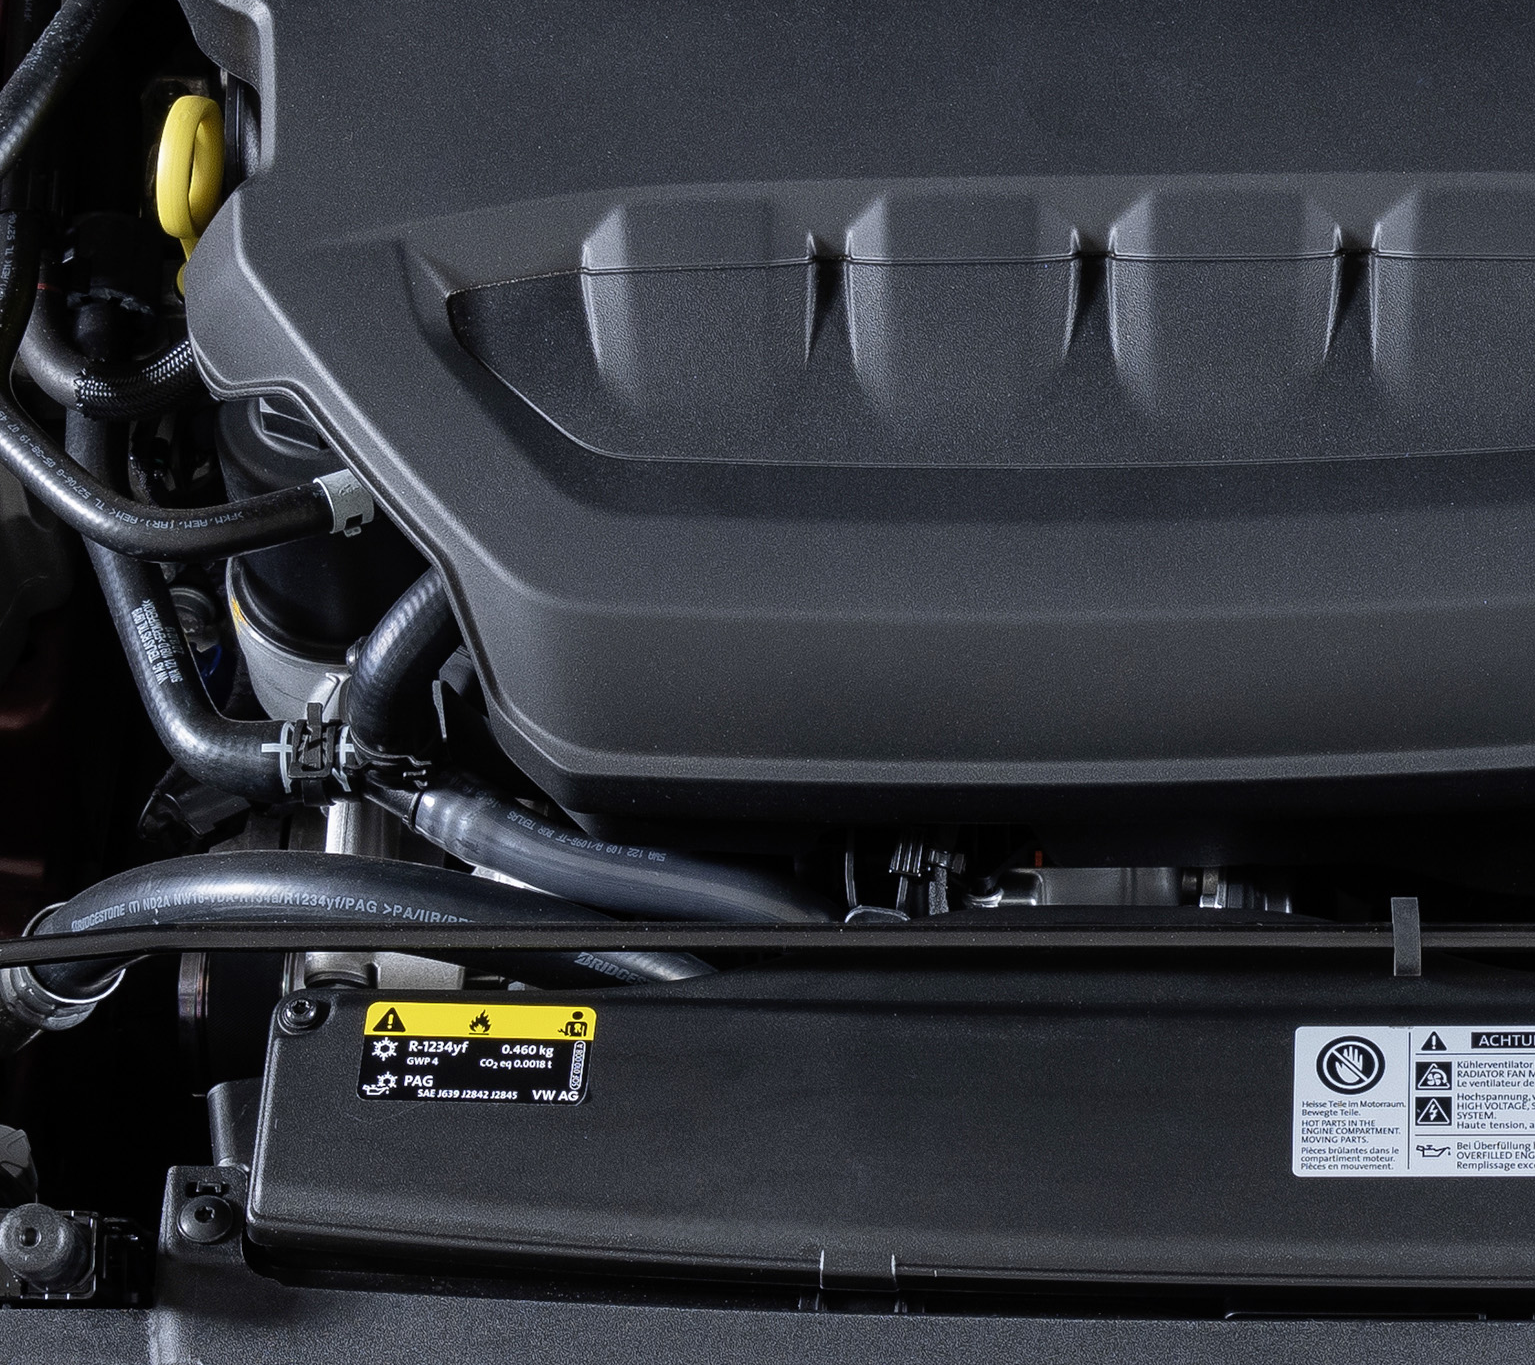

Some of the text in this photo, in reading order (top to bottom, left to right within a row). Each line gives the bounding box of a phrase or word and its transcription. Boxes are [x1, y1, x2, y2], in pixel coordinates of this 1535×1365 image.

[506, 810, 537, 831] TEKLAS
[606, 844, 623, 855] 109
[628, 847, 644, 859] 122
[71, 902, 126, 933] BRIDGESTONE
[408, 1040, 554, 1058] R-1234yf 0.460 kg
[406, 1057, 439, 1066] GWP 4
[500, 1061, 512, 1070] eq
[513, 1059, 545, 1068] 0.0018
[547, 1060, 552, 1068] t
[1457, 1060, 1534, 1069] Kühlerventilator
[1457, 1070, 1505, 1078] RADIATOR
[1507, 1070, 1526, 1078] FAN
[403, 1075, 434, 1087] PAG
[1457, 1079, 1468, 1088] Le
[1469, 1079, 1521, 1088] ventilateur
[1523, 1079, 1535, 1088] de
[417, 1088, 518, 1100] SAE J639 J2842 J2845
[532, 1090, 579, 1101] VW AG
[1456, 1093, 1531, 1102] Hochspannung,
[1457, 1102, 1483, 1110] HIGH
[1484, 1102, 1530, 1110] VOLTAGE,
[1301, 1109, 1361, 1118] Bewegte Teile.
[1457, 1111, 1497, 1120] SYSTEM.
[1301, 1119, 1375, 1127] HOT PARTS IN THE
[1457, 1121, 1486, 1130] Haute
[1489, 1121, 1528, 1130] tension,
[1301, 1127, 1400, 1135] ENGINE COMPARTMENT.
[1301, 1136, 1369, 1144] MOVING PARTS.
[1457, 1141, 1471, 1150] Bei
[1473, 1140, 1531, 1151] Überfüllung
[1456, 1151, 1513, 1160] OVERFILLED
[1457, 1161, 1516, 1170] Remplissage
